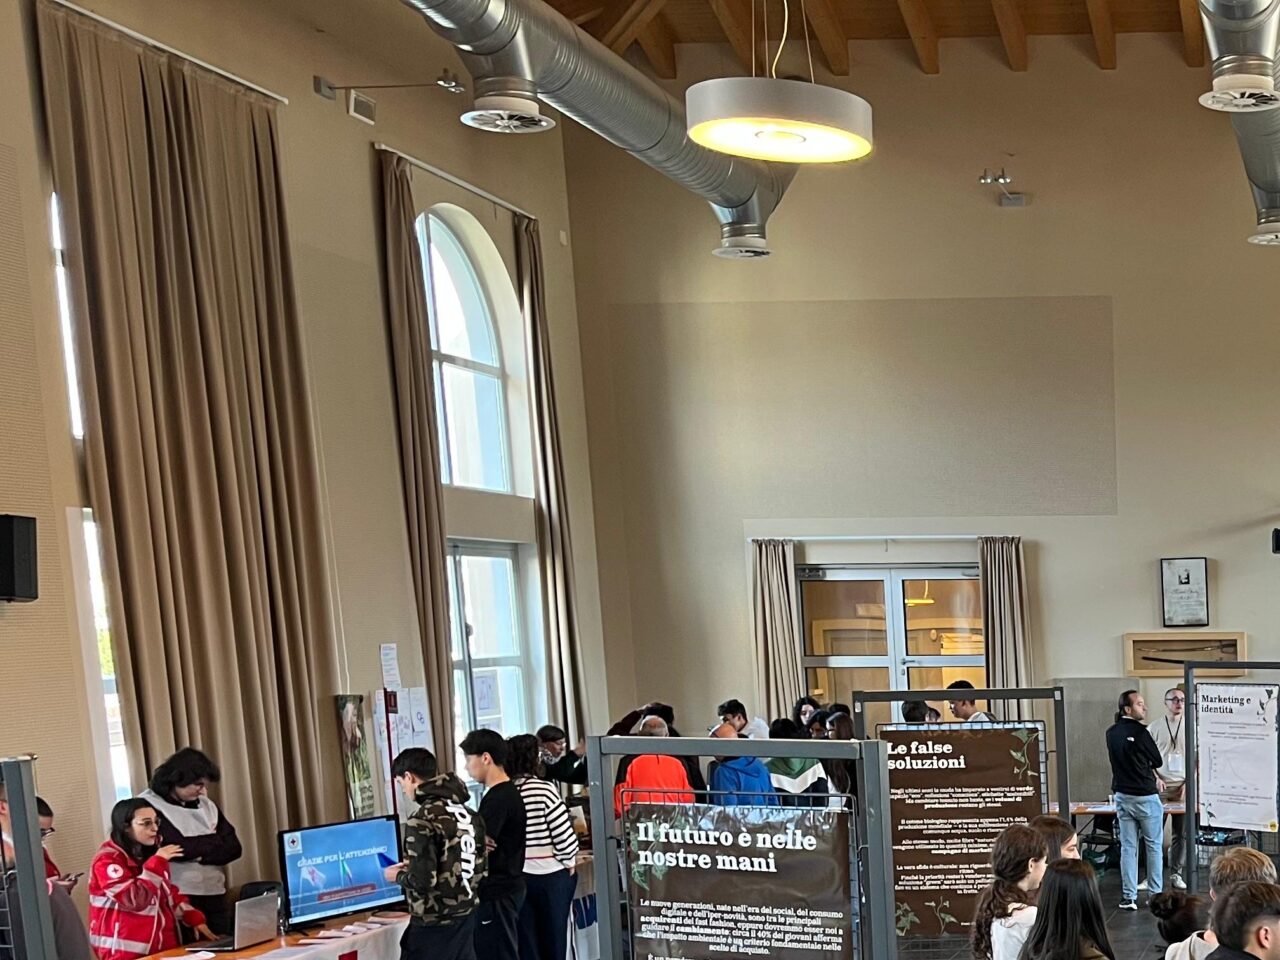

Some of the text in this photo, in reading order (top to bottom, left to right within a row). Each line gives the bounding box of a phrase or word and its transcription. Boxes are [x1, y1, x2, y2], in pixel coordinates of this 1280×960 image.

[1201, 695, 1244, 706] Marketing
[1201, 705, 1233, 714] identità
[886, 741, 952, 754] Le false
[888, 755, 966, 769] soluzioni
[637, 822, 817, 850] Il futuro è nelle
[638, 849, 777, 872] nostre mani
[733, 905, 760, 913] nell'era
[760, 906, 772, 914] del
[797, 908, 808, 916] del
[809, 910, 843, 918] consumo
[640, 915, 682, 924] acquirenti
[683, 917, 694, 925] del
[695, 917, 708, 925] fast
[737, 922, 763, 931] eppure
[764, 922, 803, 932] dovremmo
[642, 922, 669, 931] guidare
[732, 928, 749, 936] circa
[757, 930, 772, 938] 40%
[772, 931, 784, 939] dei
[785, 932, 812, 941] giovani
[813, 934, 842, 943] afferma
